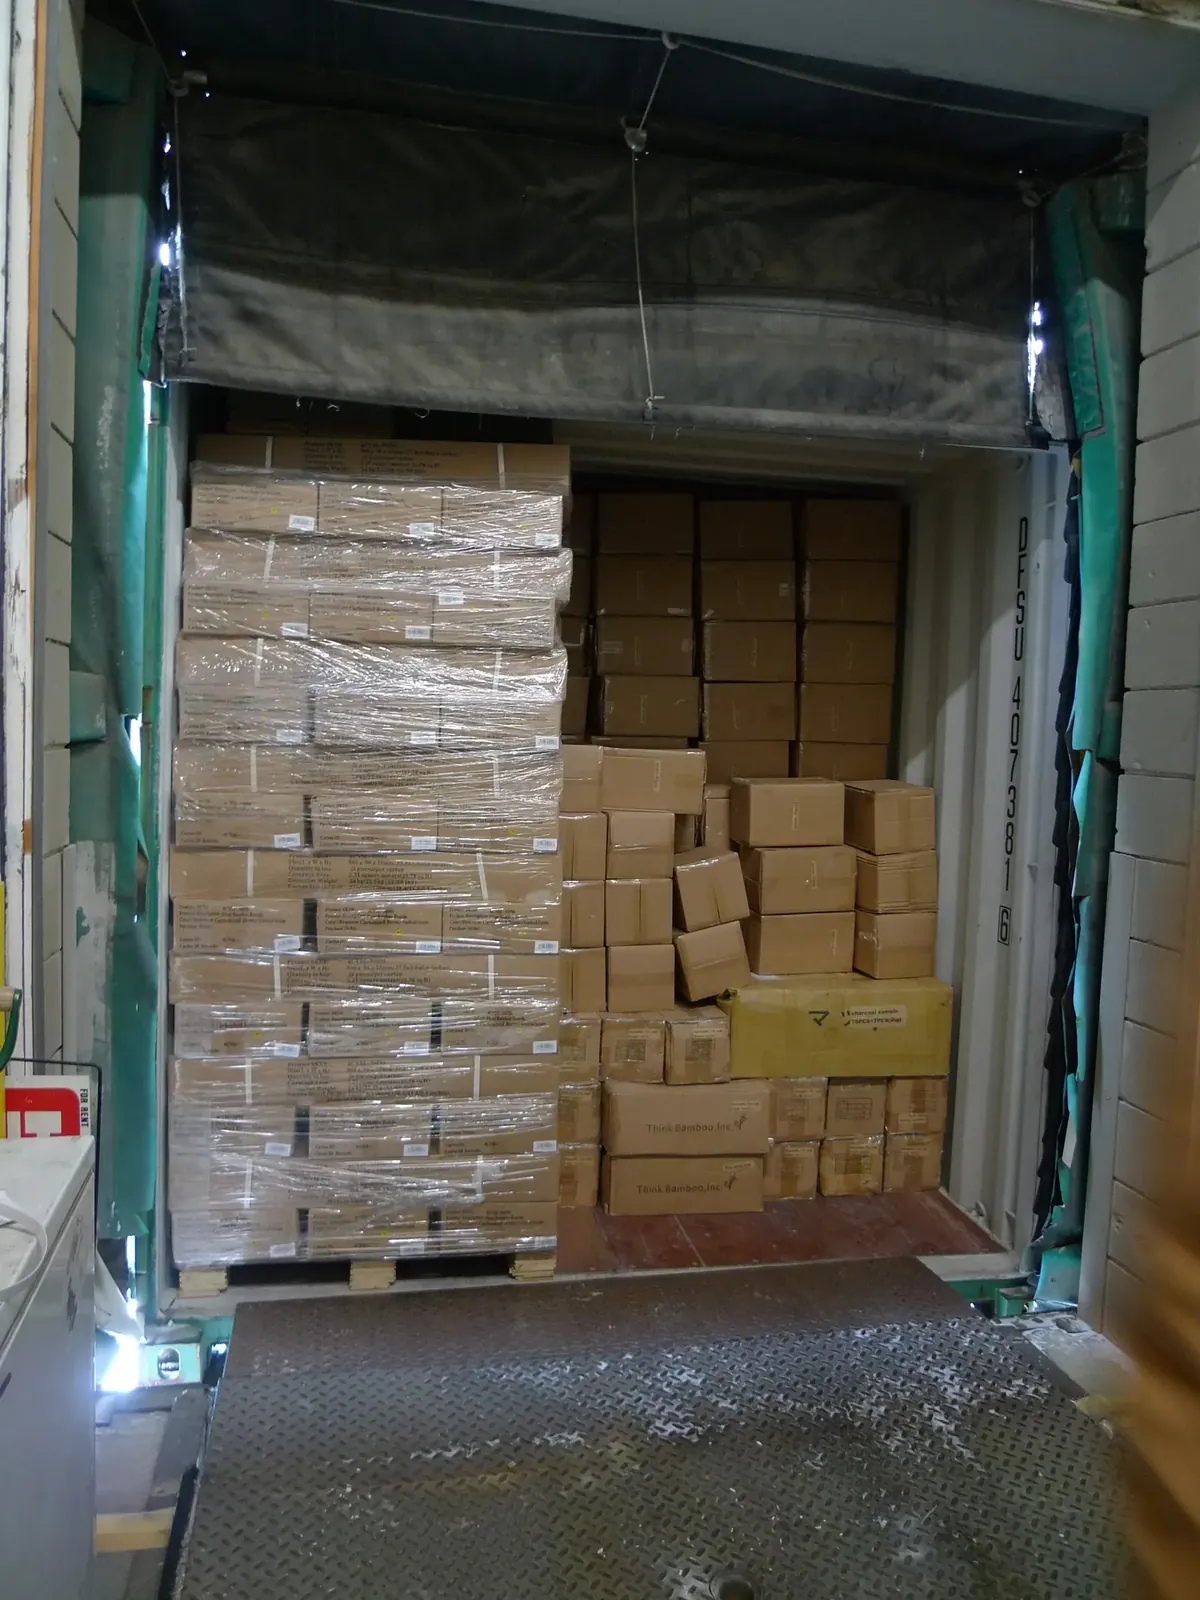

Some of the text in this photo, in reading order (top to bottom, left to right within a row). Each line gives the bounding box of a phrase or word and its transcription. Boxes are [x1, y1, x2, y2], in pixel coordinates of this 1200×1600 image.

[999, 516, 1028, 943] DFSU 407381 6
[80, 1089, 88, 1103] FOR
[646, 1124, 672, 1133] Think
[637, 1185, 663, 1194] Think
